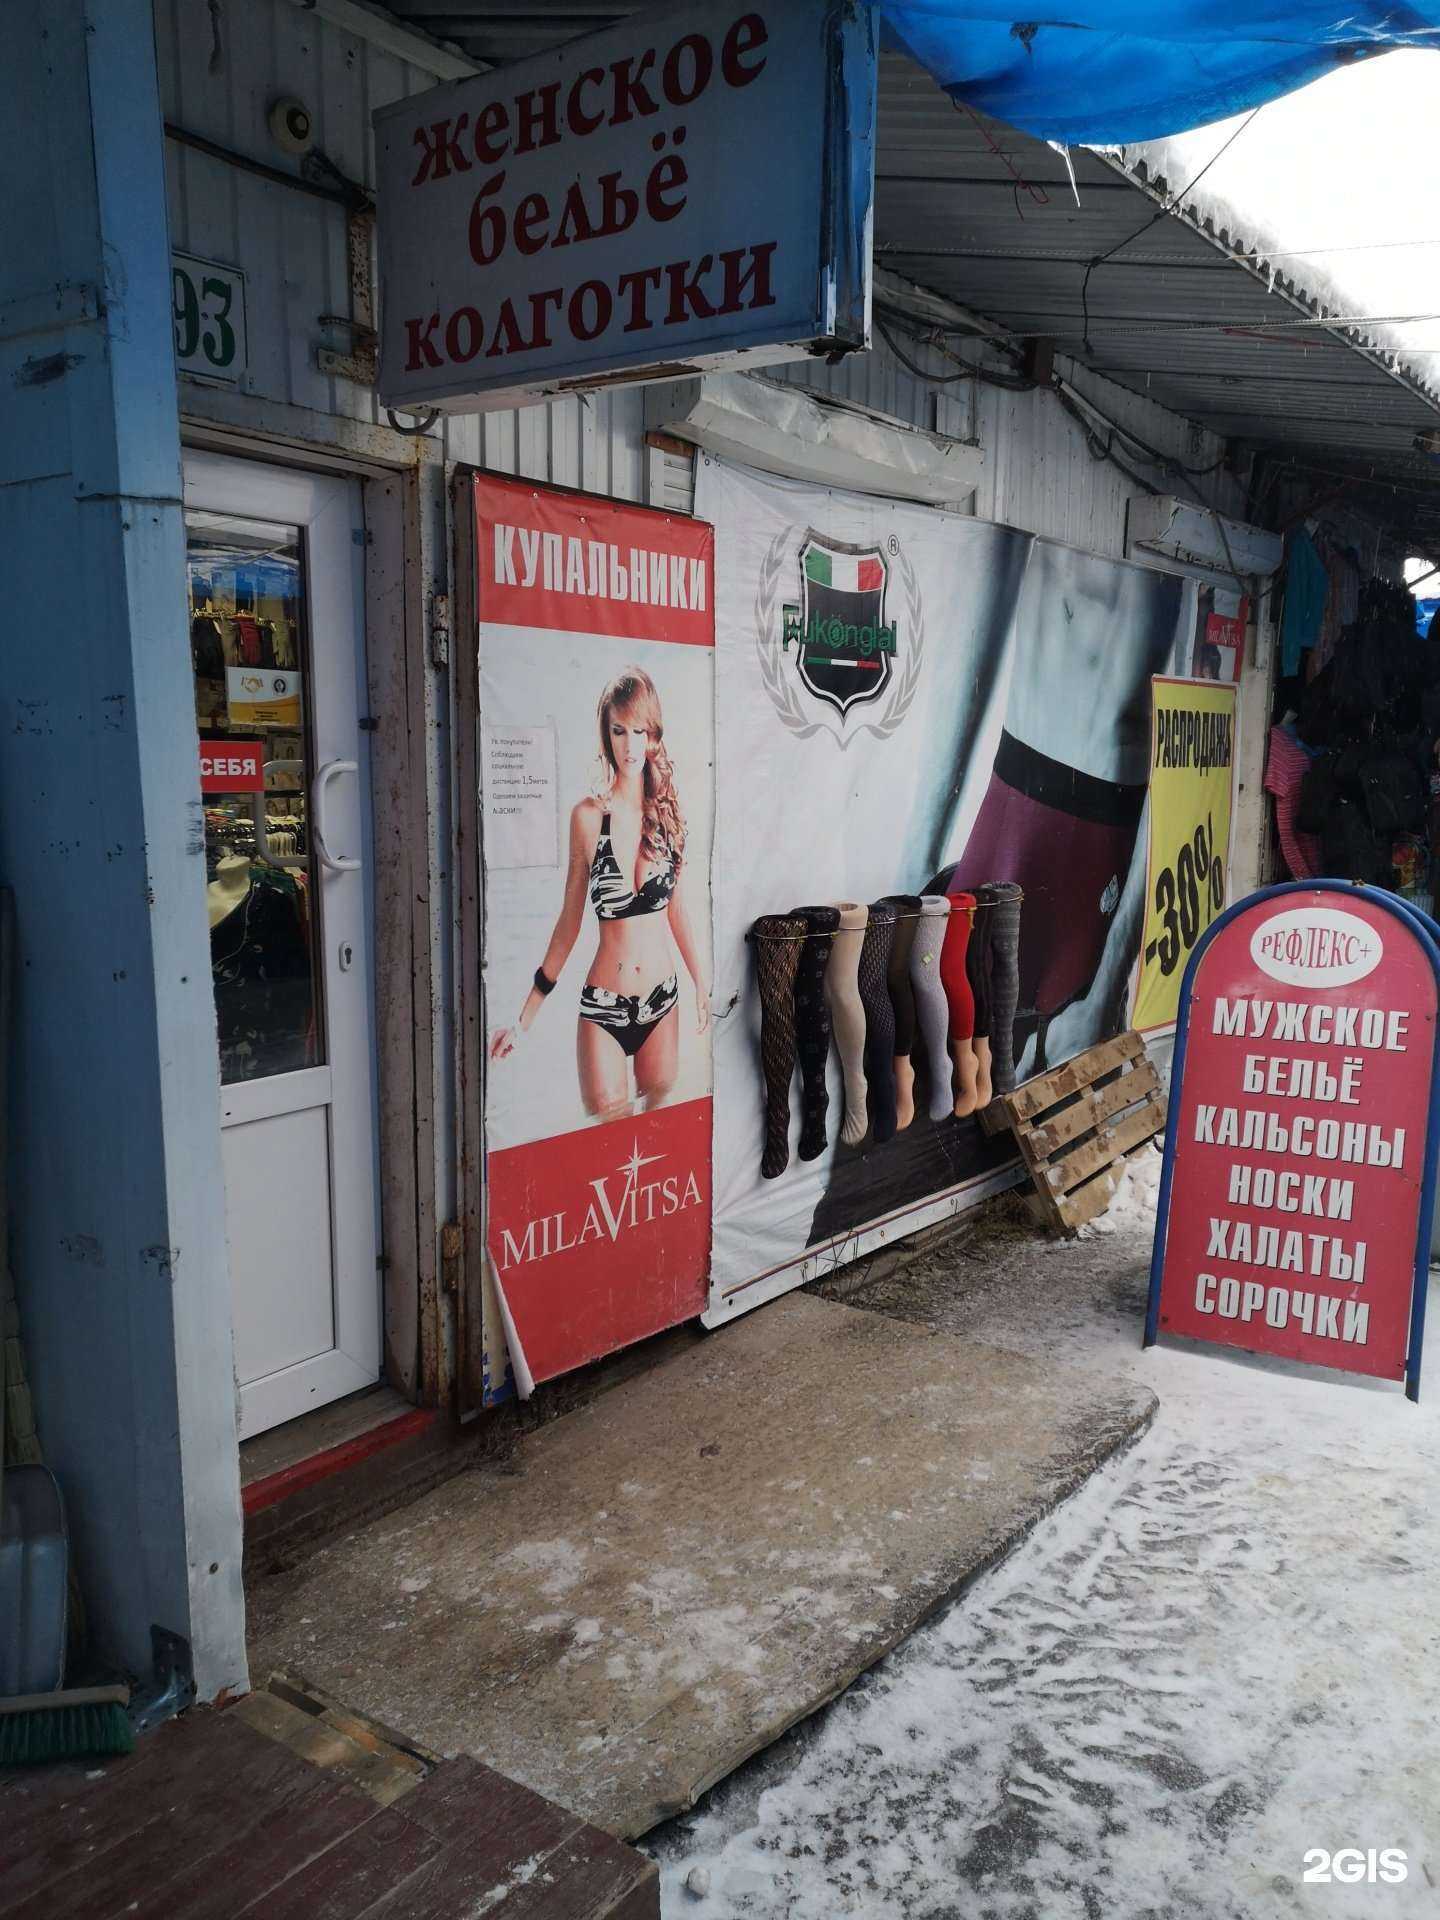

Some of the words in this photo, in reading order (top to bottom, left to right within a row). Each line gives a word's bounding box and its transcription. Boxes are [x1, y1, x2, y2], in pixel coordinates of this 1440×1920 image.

[412, 13, 769, 187] женское
[468, 126, 689, 267] бельё
[404, 241, 778, 372] колготки
[494, 523, 706, 612] КУПАЛЬНИКИ
[200, 758, 257, 776] СЕБЯ
[1156, 709, 1232, 777] РАСПРОДАЖА
[1145, 811, 1224, 976] -30%
[1212, 997, 1410, 1052] МУЖСКОЕ
[1243, 1054, 1364, 1105] БЕЛЬЁ
[1194, 1104, 1406, 1169] КАЛЬСОНЫ
[500, 1168, 703, 1271] MILAVITSA
[1229, 1164, 1355, 1221] НОСКИ
[1206, 1217, 1367, 1284] ХАЛАТЫ
[1195, 1273, 1371, 1345] СОРОЧКИ
